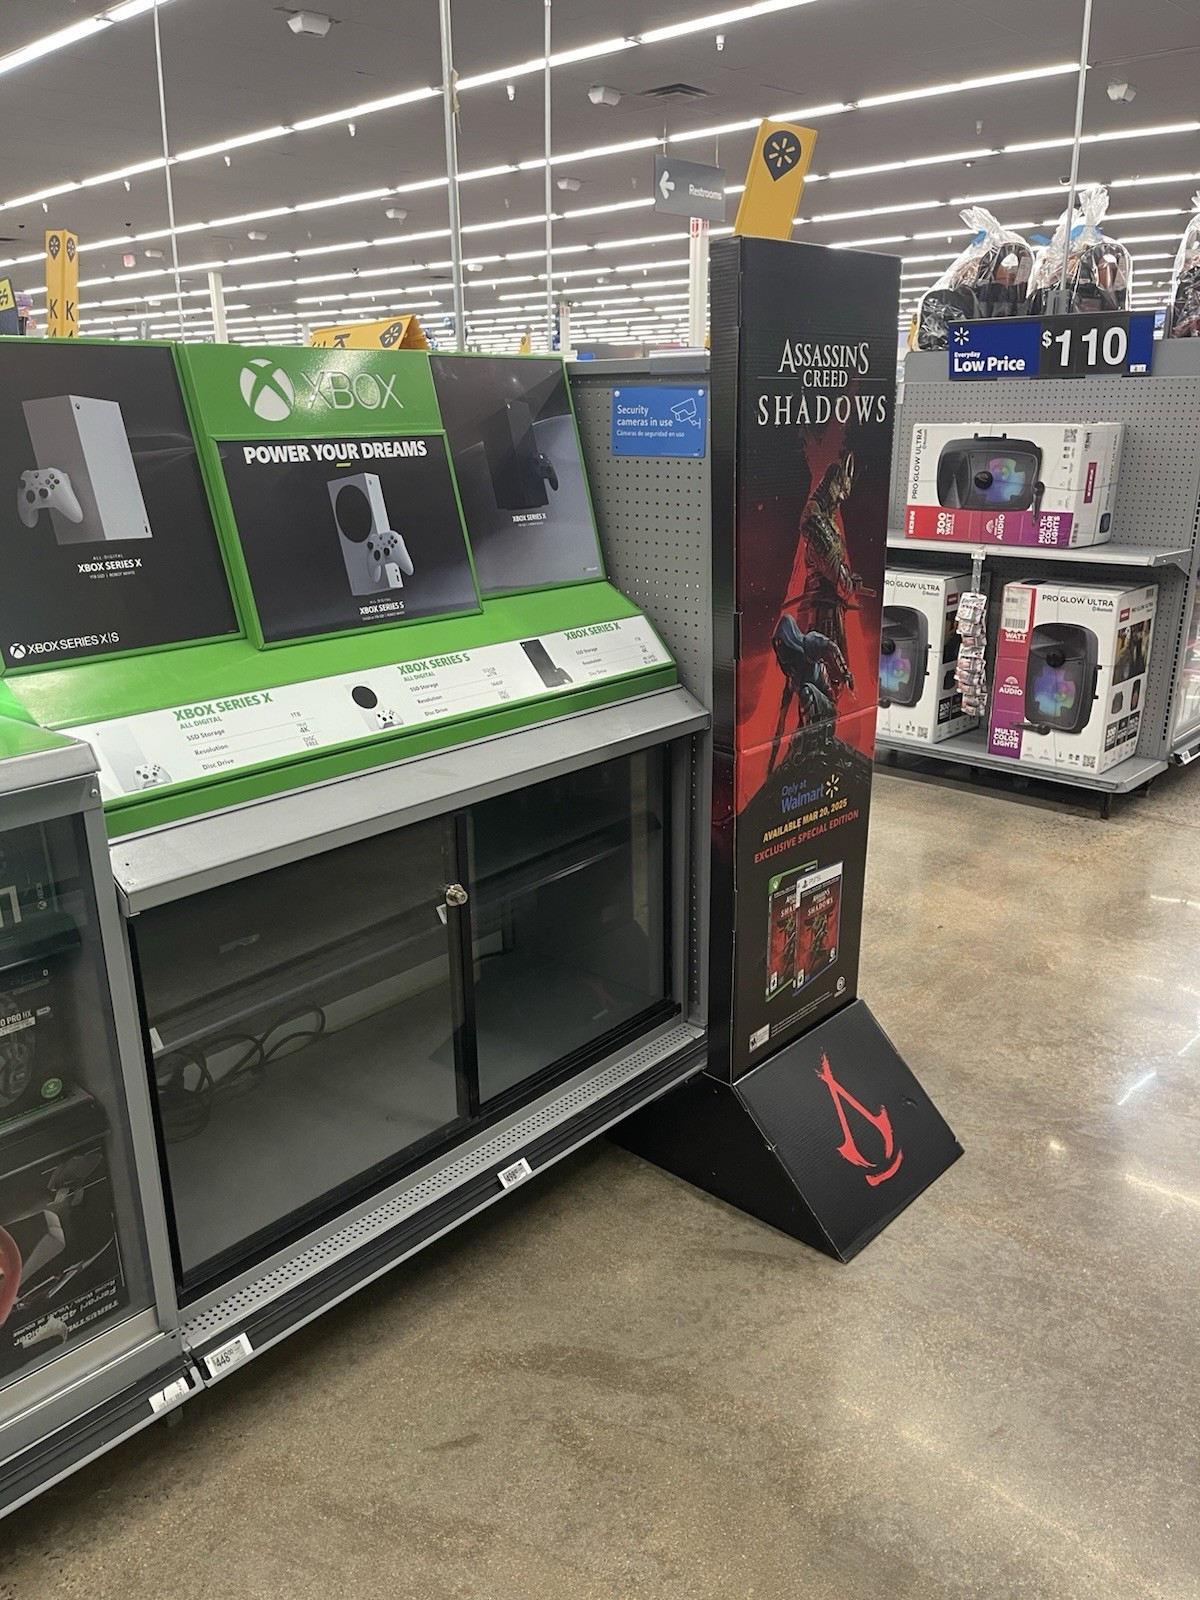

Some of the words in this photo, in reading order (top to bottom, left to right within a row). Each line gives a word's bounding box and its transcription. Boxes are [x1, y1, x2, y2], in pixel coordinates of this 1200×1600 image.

[689, 184, 722, 200] Restrooms
[50, 299, 58, 319] K
[66, 301, 74, 322] K
[954, 358, 986, 372] Low
[988, 356, 1026, 372] Price
[803, 370, 848, 388] CREED
[300, 371, 404, 410] XBOX
[617, 405, 648, 416] Security
[758, 394, 887, 426] SHADOWS
[617, 418, 648, 426] cameras
[650, 417, 658, 426] in
[660, 419, 674, 427] use
[645, 430, 668, 438] seguridad
[916, 428, 924, 454] ULTRA
[243, 444, 310, 464] POWER
[311, 442, 360, 462] YOUR
[360, 440, 428, 460] DREAMS
[526, 513, 542, 521] SERIES
[936, 512, 946, 535] 300
[996, 514, 1006, 540] AUDIO
[1038, 516, 1046, 544] MULTI-
[1045, 516, 1054, 544] COLOR
[1052, 516, 1060, 544] LIGHTS
[78, 562, 104, 573] XBOX
[105, 559, 134, 570] SERIES
[134, 558, 142, 568] X
[896, 580, 917, 588] GLOW
[918, 584, 940, 592] ULTRA
[360, 604, 380, 614] XBOX
[380, 602, 399, 612] SERIES
[1042, 594, 1058, 603] PRO
[1060, 596, 1086, 605] GLOW
[1087, 598, 1114, 607] ULTRA
[564, 630, 588, 640] XBOX
[588, 624, 614, 636] SERIES
[614, 622, 621, 630] X
[1005, 632, 1027, 640] WATT
[28, 640, 60, 654] XBOX
[60, 635, 99, 650] SERIES
[99, 632, 120, 645] X|S
[398, 661, 430, 676] XBOX
[430, 655, 462, 669] SERIES
[462, 652, 471, 662] S
[414, 671, 436, 680] DIGITAL
[420, 682, 439, 691] Storage
[998, 687, 1024, 696] AUDIO
[173, 704, 216, 722] XBOX
[216, 696, 261, 713] SERIES
[260, 692, 274, 703] X
[418, 695, 443, 704] Resolution
[180, 721, 193, 730] ALL
[194, 716, 223, 727] DIGITAL
[300, 726, 310, 734] 4K
[186, 734, 200, 742] SSD
[201, 728, 226, 740] Storage
[993, 733, 1019, 744] COLOR
[994, 727, 1020, 737] MULTI-
[194, 743, 229, 756] Resolution
[993, 739, 1018, 750] LIGHTS
[202, 762, 216, 771] Disc
[217, 758, 234, 768] Drive
[782, 783, 798, 796] Only
[800, 780, 806, 788] at
[781, 784, 824, 813] Walmart
[763, 818, 802, 842] AVAILABLE
[802, 811, 818, 824] MAR
[819, 806, 830, 818] 20,
[830, 798, 848, 812] 2025
[754, 836, 797, 864] EXCLUSIVE
[797, 823, 828, 844] SPECIAL
[829, 810, 859, 830] EDITION
[780, 904, 798, 918] SHAD
[808, 896, 834, 916] SHADOWS
[6, 1015, 22, 1026] PRO
[22, 1010, 32, 1020] HX
[80, 1286, 116, 1311] Ferrari
